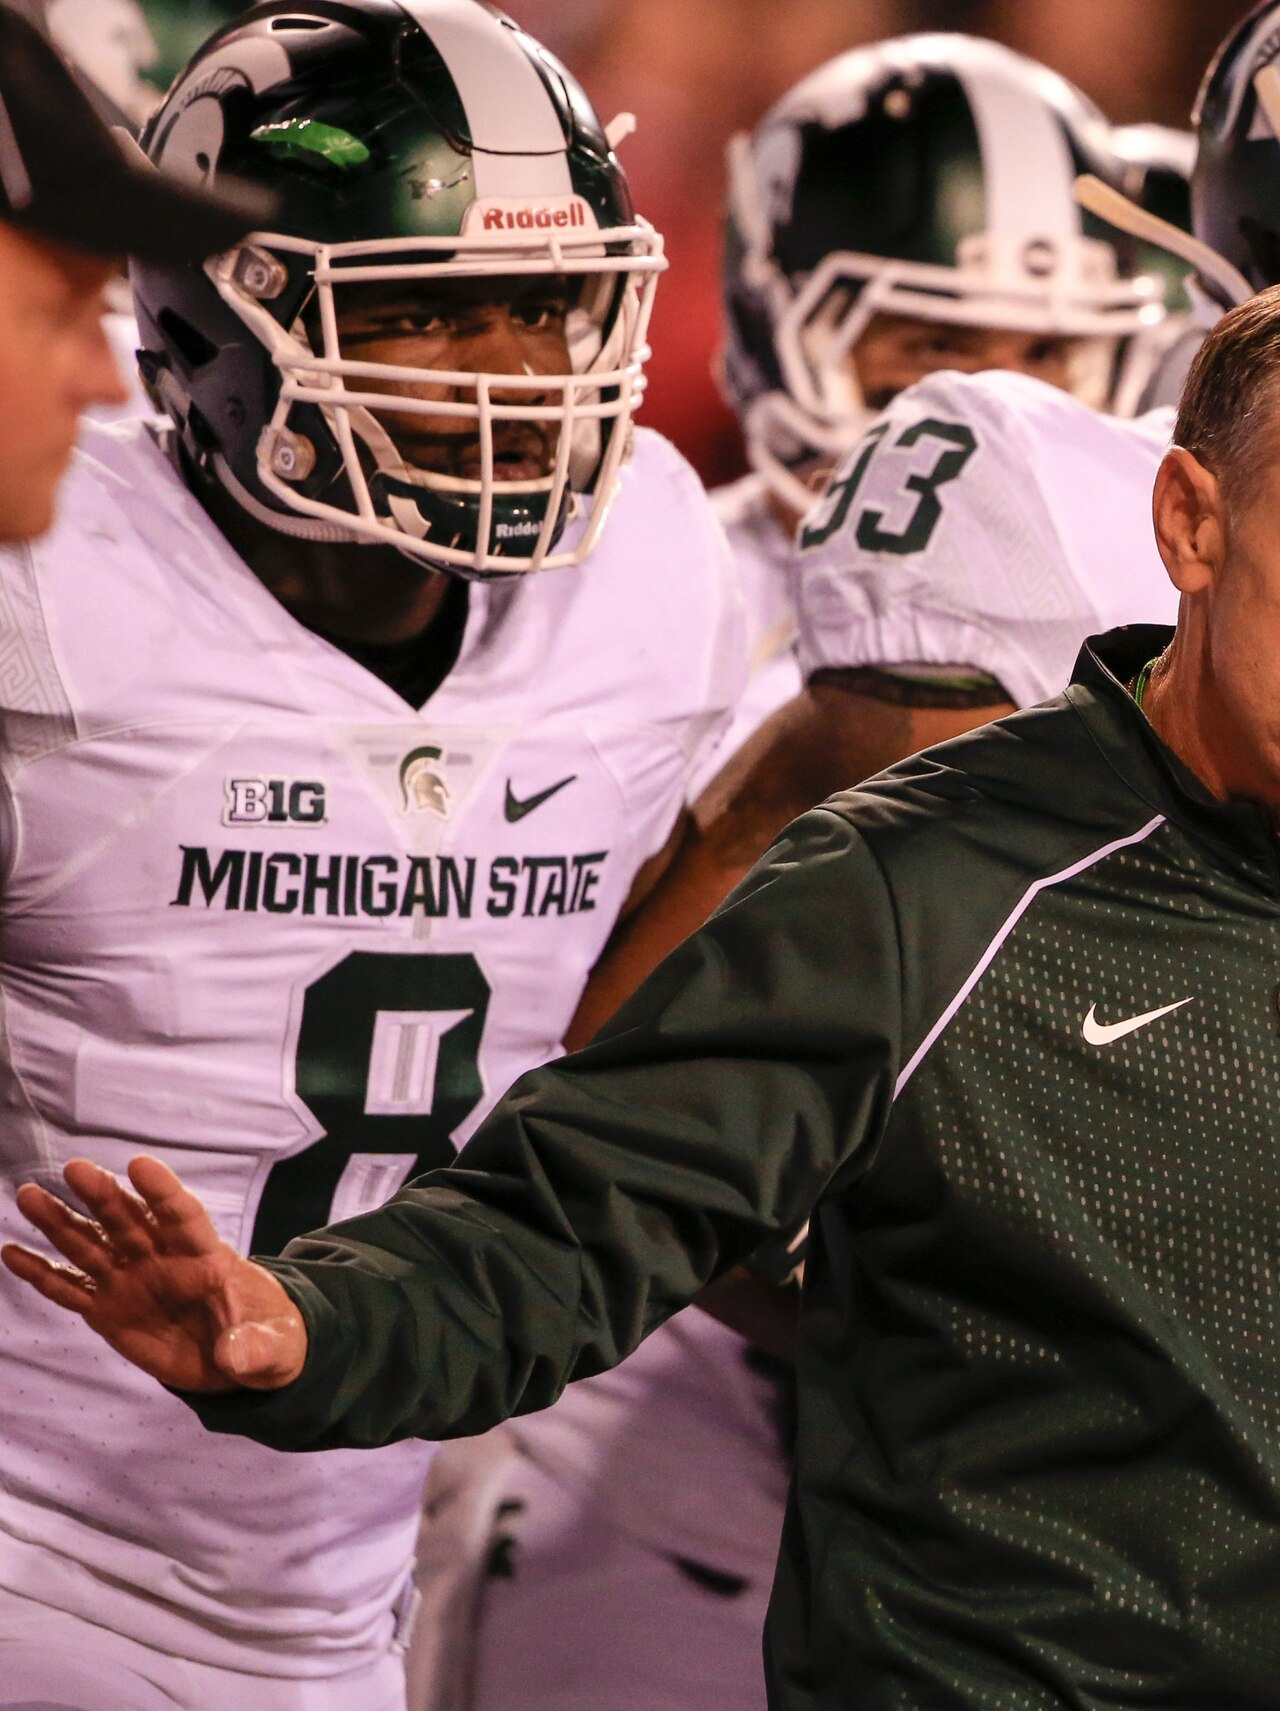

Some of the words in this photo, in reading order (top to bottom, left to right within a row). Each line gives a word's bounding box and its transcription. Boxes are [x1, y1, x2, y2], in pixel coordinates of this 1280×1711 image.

[483, 202, 585, 231] Riddell
[169, 844, 477, 918] MICHIGAN
[486, 850, 609, 917] STATE
[248, 950, 492, 1259] 8
